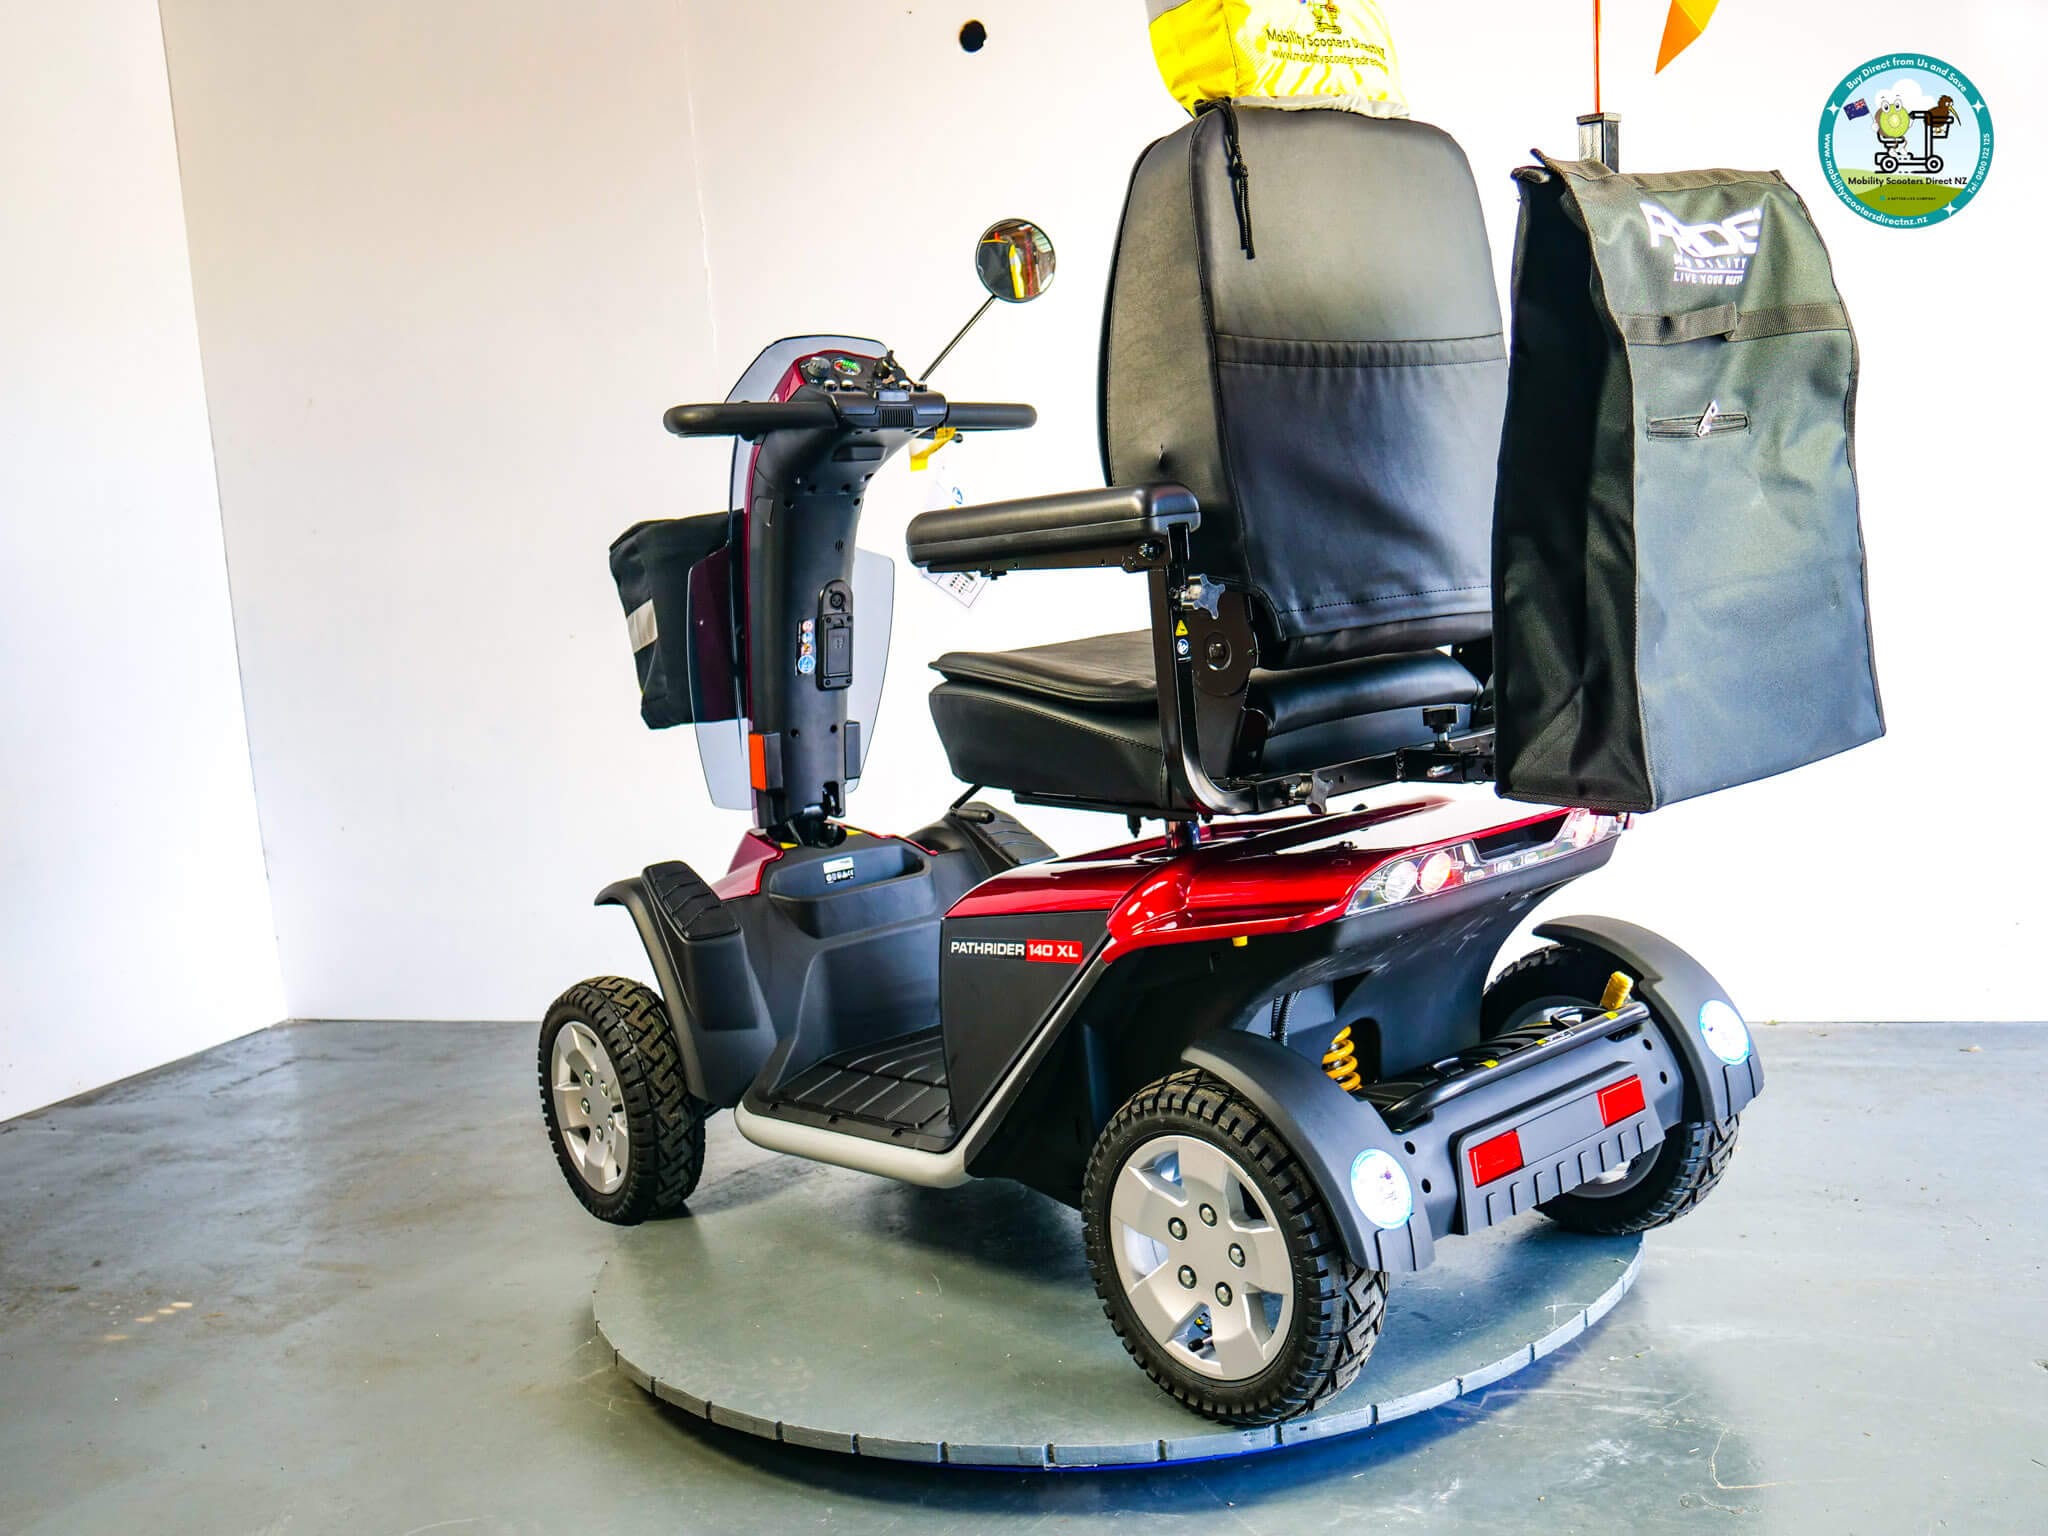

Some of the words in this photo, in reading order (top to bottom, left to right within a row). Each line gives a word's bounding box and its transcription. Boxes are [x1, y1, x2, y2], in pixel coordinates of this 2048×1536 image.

[1265, 28, 1306, 49] Mobility
[1306, 34, 1351, 48] Scooters
[1673, 271, 1698, 284] LIVE
[950, 941, 1026, 956] PATHRIDER
[1028, 943, 1054, 957] 140
[1057, 944, 1080, 958] XL
